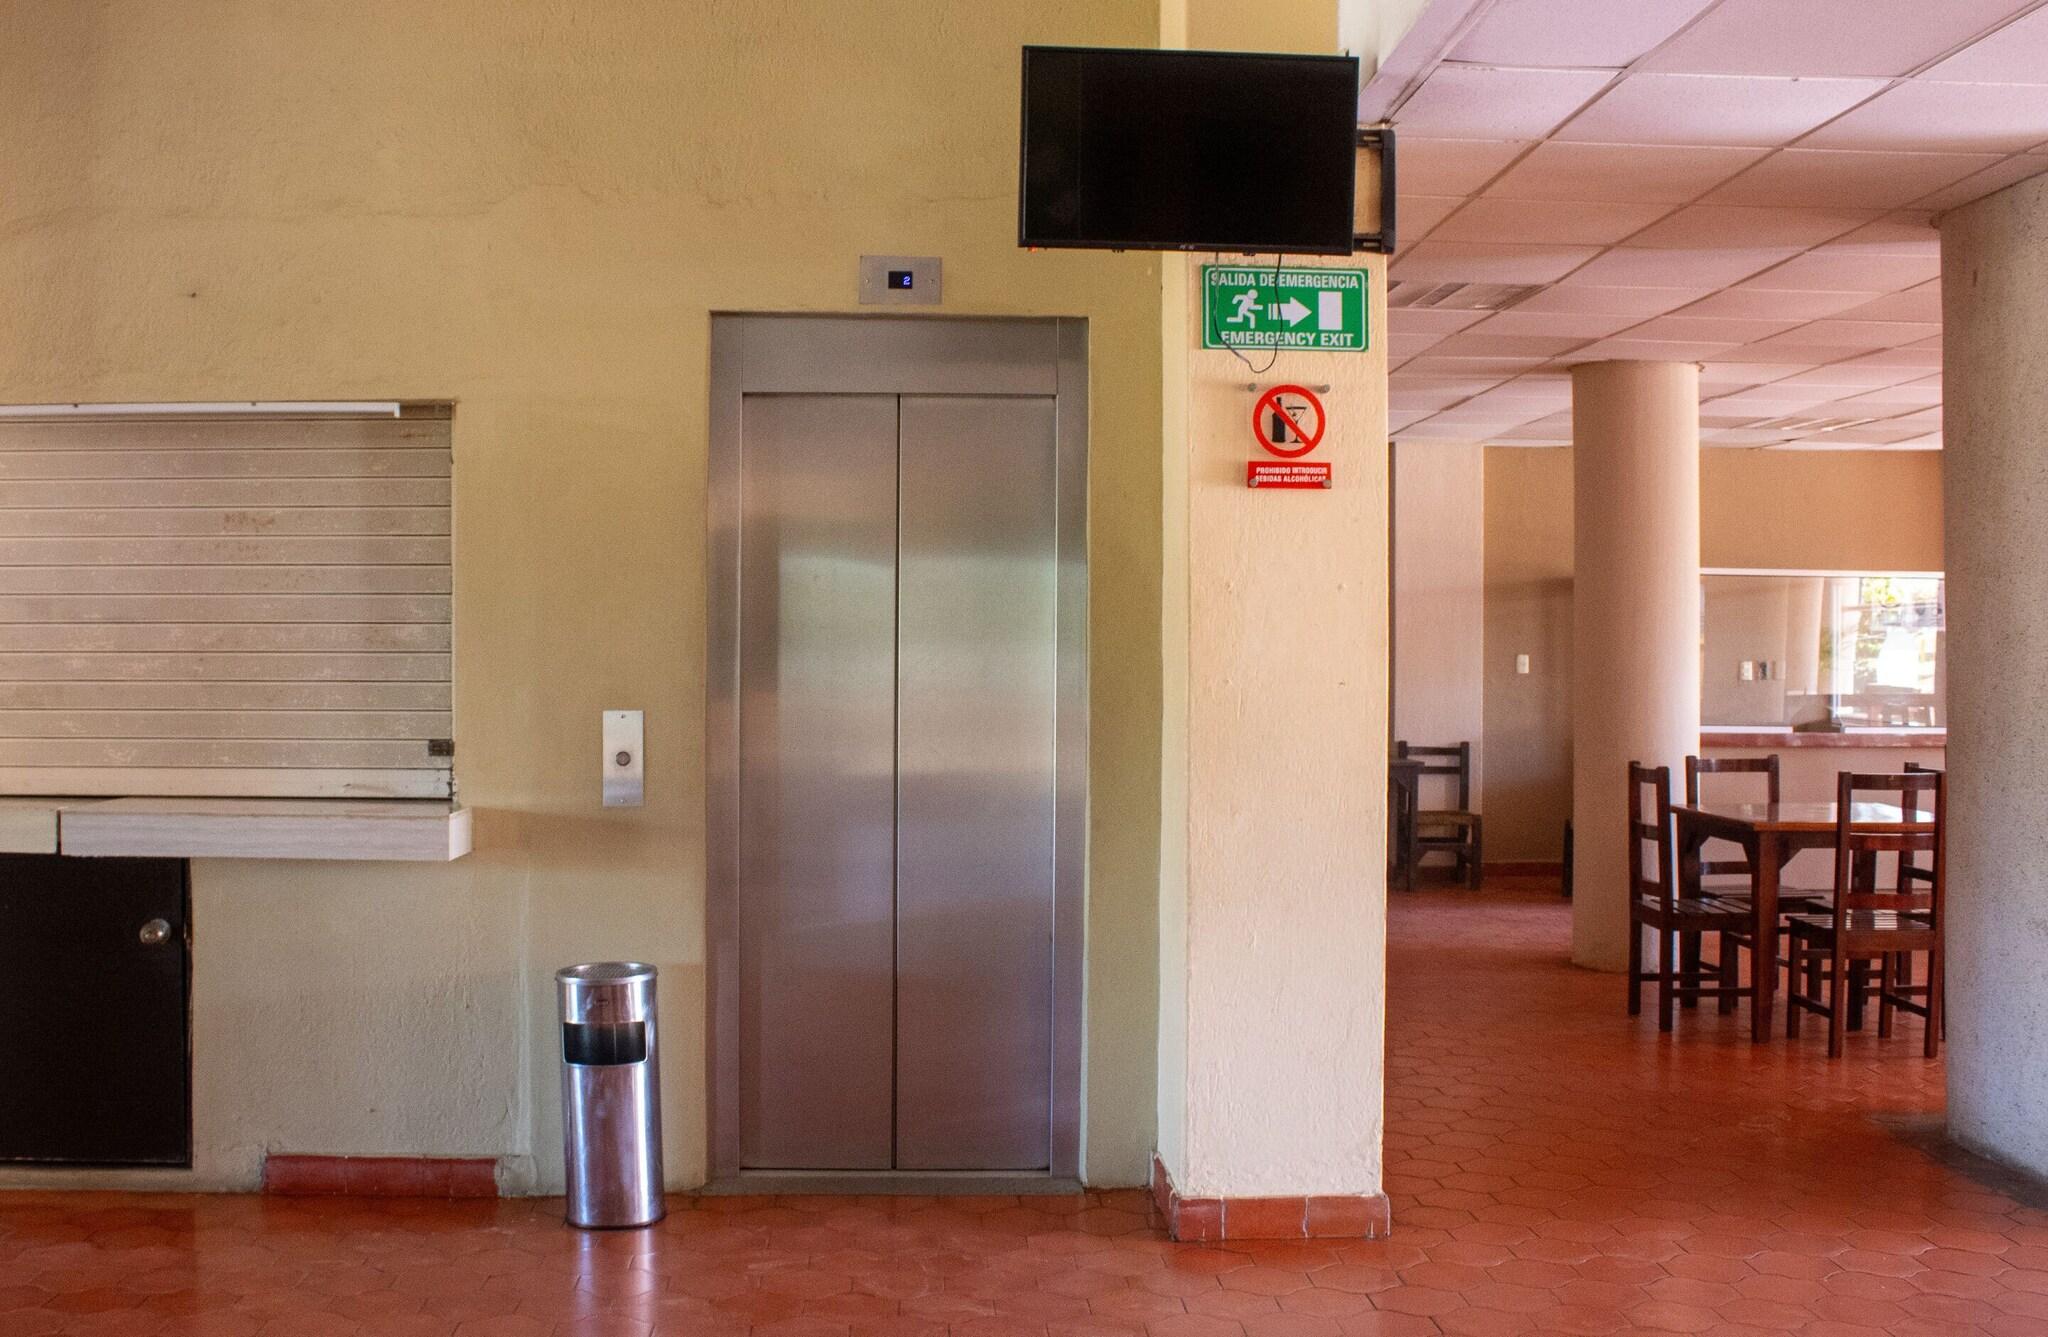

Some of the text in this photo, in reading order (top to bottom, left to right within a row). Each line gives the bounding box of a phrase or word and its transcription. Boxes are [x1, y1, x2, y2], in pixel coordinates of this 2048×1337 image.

[903, 276, 911, 285] 2
[1211, 272, 1358, 288] SALIDA DE EMERGENCIA
[1221, 331, 1354, 346] EMERGENCY EXIT
